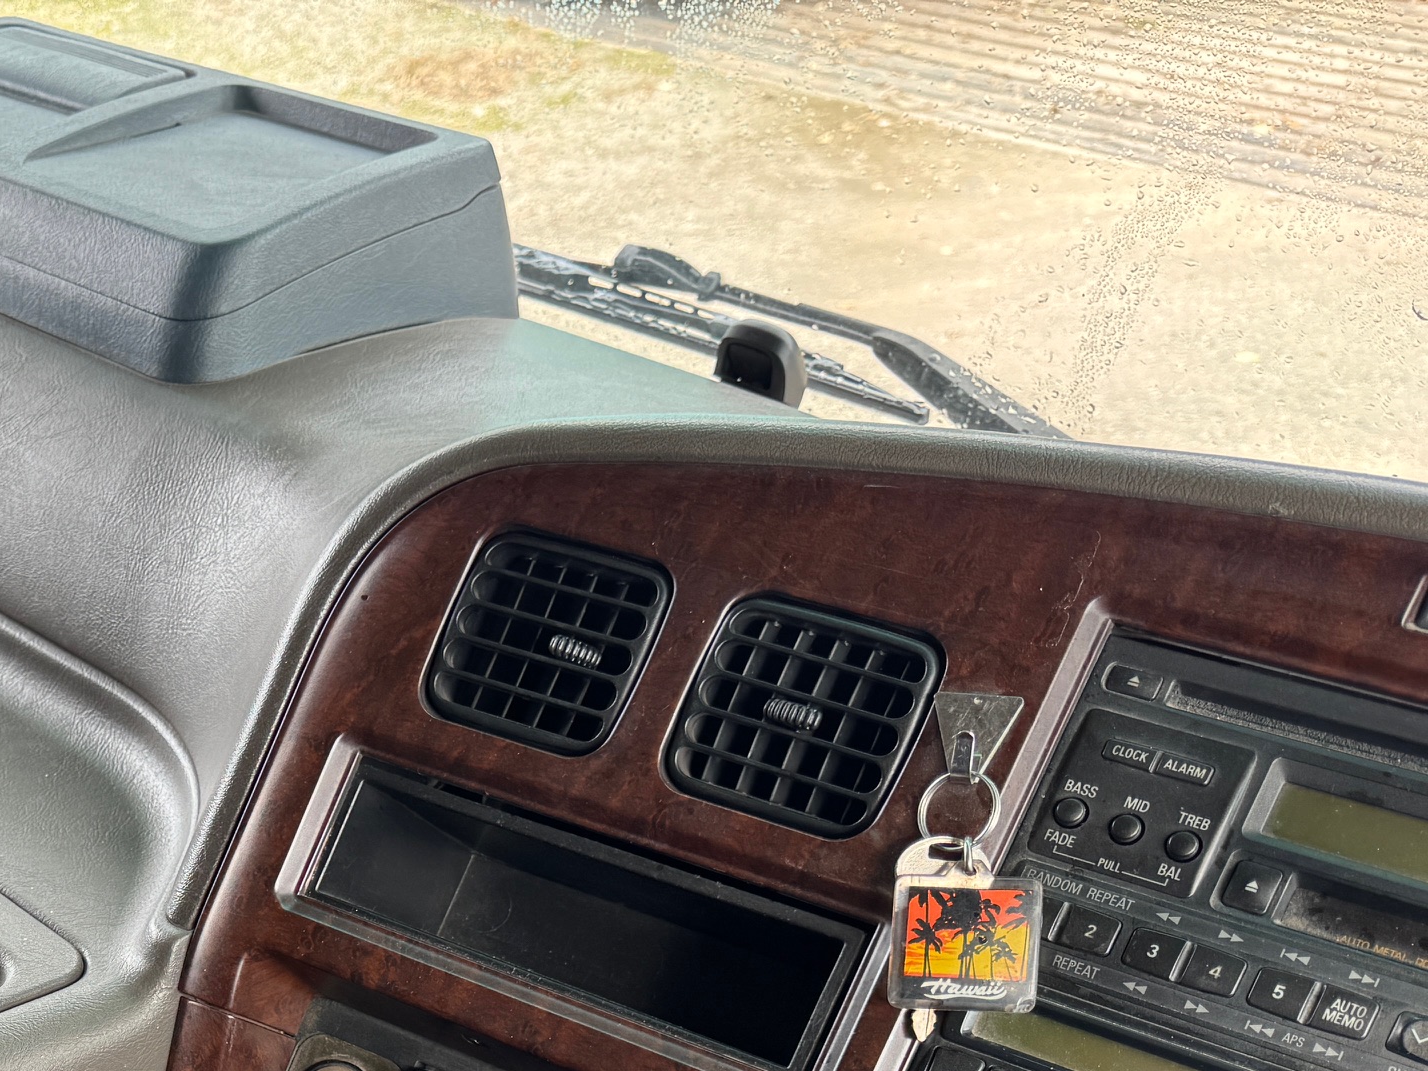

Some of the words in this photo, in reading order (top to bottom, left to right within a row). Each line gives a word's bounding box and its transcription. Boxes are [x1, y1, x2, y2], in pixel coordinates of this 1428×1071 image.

[1112, 744, 1150, 763] CLOCK
[1163, 758, 1207, 780] ALARM
[1064, 778, 1099, 798] BASS
[1123, 796, 1151, 813] MID
[1178, 811, 1211, 831] TREB
[1044, 829, 1077, 848] FADE
[1097, 858, 1122, 874] PULL
[1157, 863, 1182, 881] BAL
[1027, 868, 1084, 896] RANDOM
[1086, 887, 1136, 911] REPEAT
[1083, 924, 1098, 939] 2
[1146, 944, 1160, 958] 3
[1052, 955, 1100, 980] REPEAT
[1208, 965, 1222, 979] 4
[920, 978, 1007, 1000] Hawaii
[1272, 984, 1286, 999] 5
[1330, 998, 1368, 1019] AUTO
[1322, 1008, 1365, 1031] MEMO
[1281, 1032, 1306, 1048] APS
